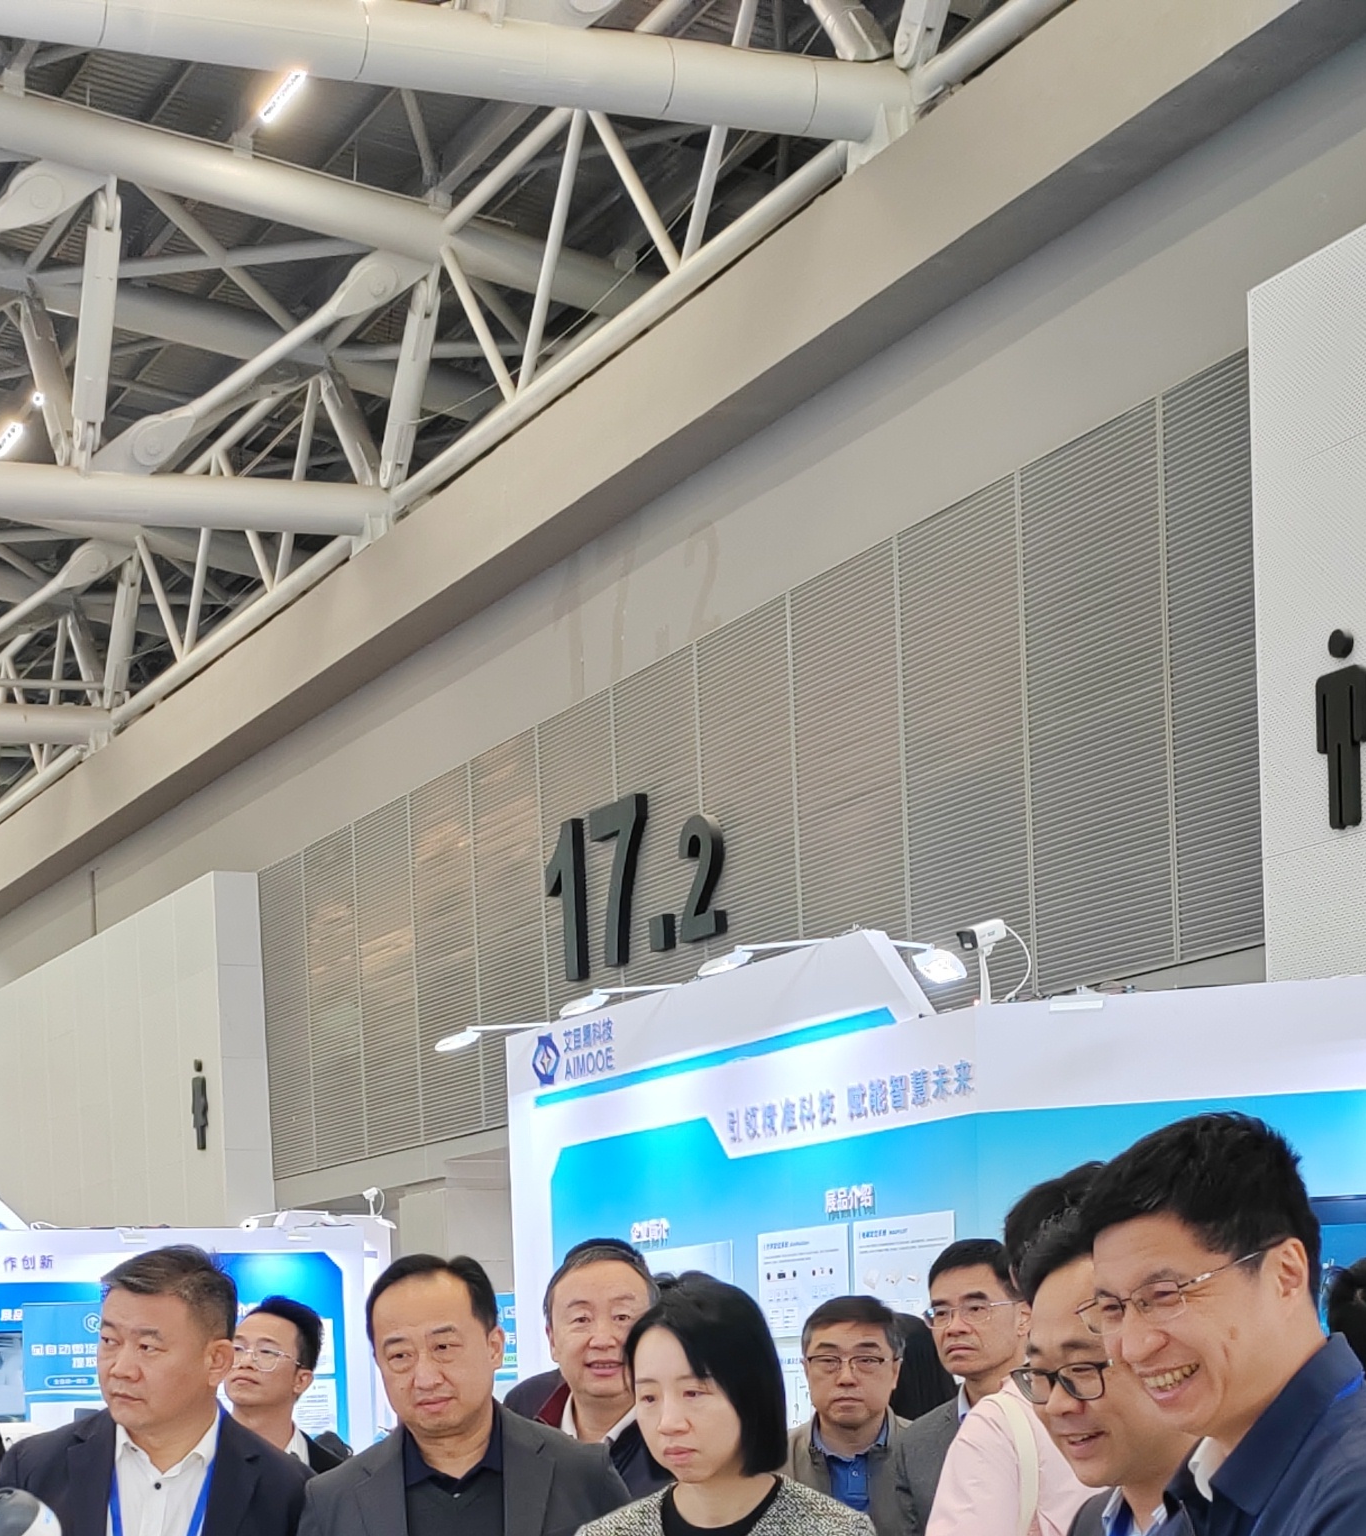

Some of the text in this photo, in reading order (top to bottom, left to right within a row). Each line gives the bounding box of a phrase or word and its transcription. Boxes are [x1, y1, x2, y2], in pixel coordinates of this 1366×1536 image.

[544, 793, 727, 980] 17.2
[564, 1047, 616, 1081] AIMOOE
[726, 1059, 975, 1143] 引领精准科技 赋能智慧未来
[824, 1185, 875, 1211] 展品介绍
